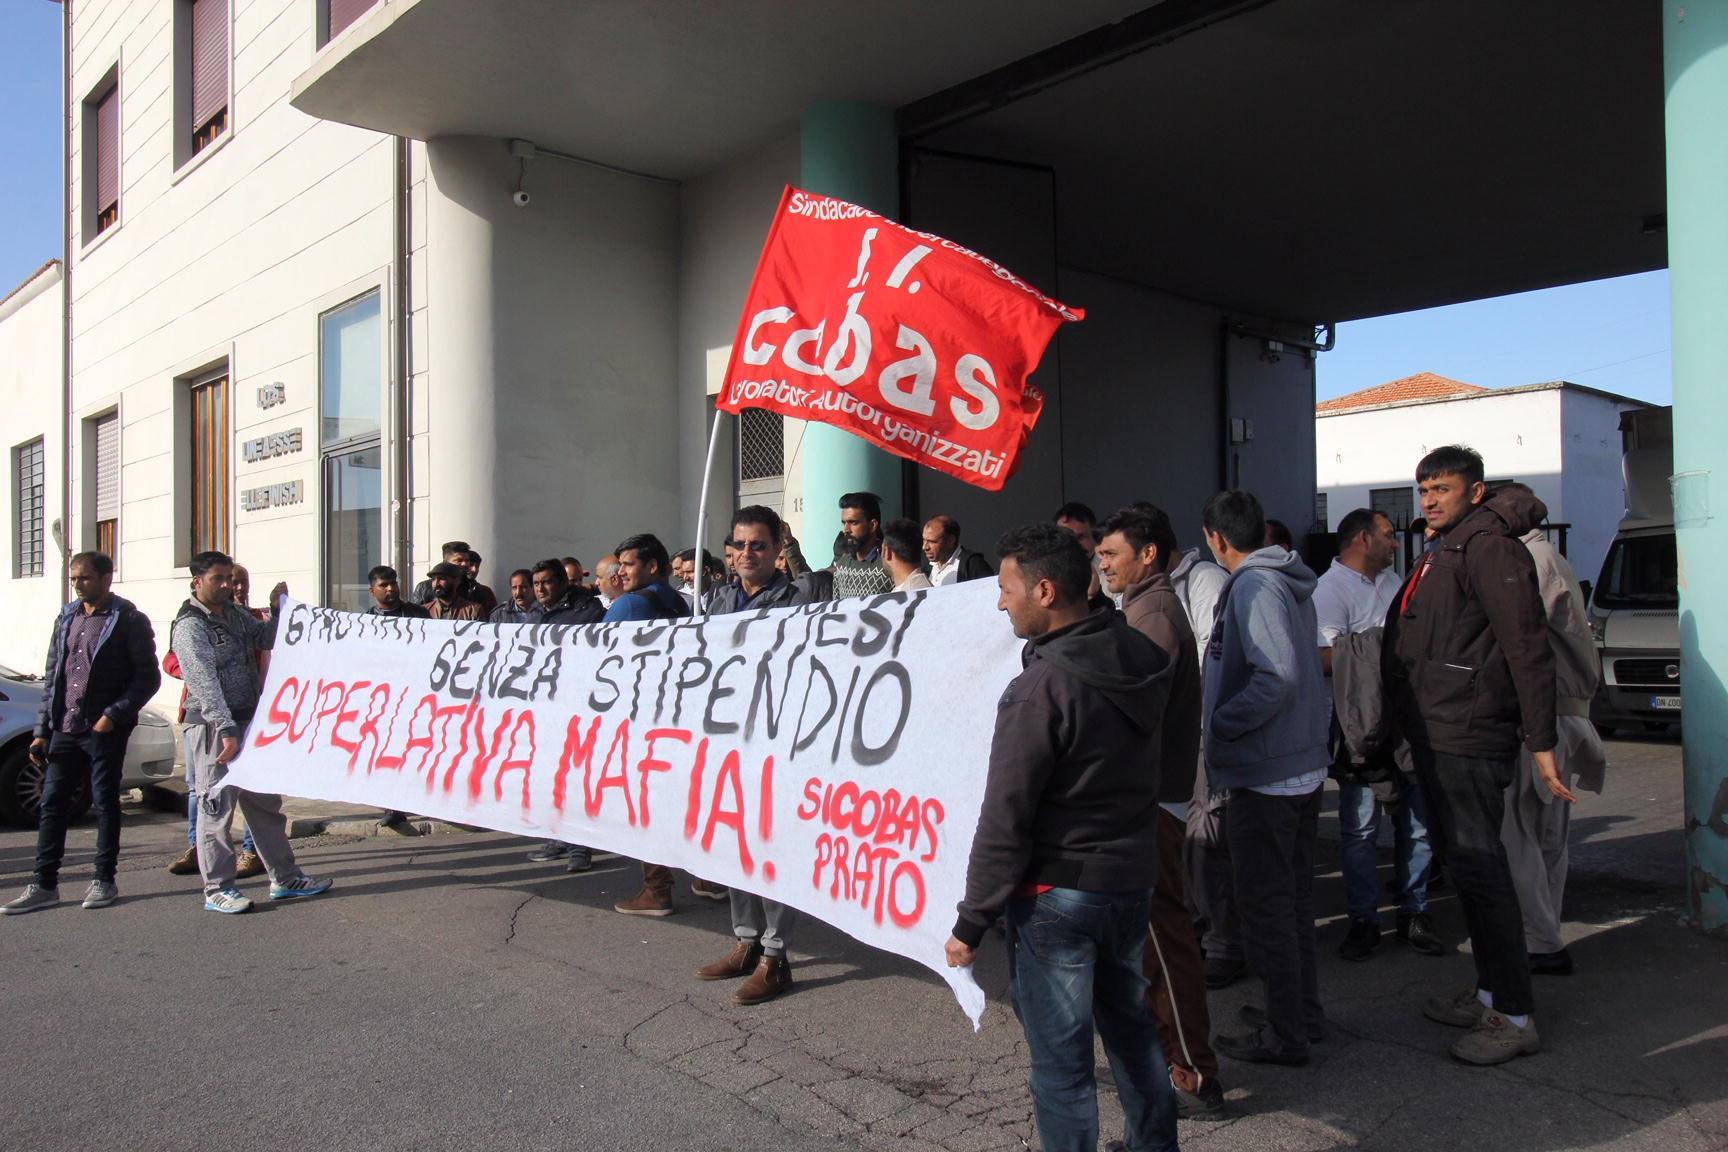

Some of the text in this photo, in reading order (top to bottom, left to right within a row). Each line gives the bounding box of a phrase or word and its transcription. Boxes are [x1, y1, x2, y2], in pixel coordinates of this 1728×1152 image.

[588, 644, 913, 766] STIPENDIO
[255, 676, 777, 882] SUPERLATIVA MAFIA!
[813, 832, 927, 930] PRATO
